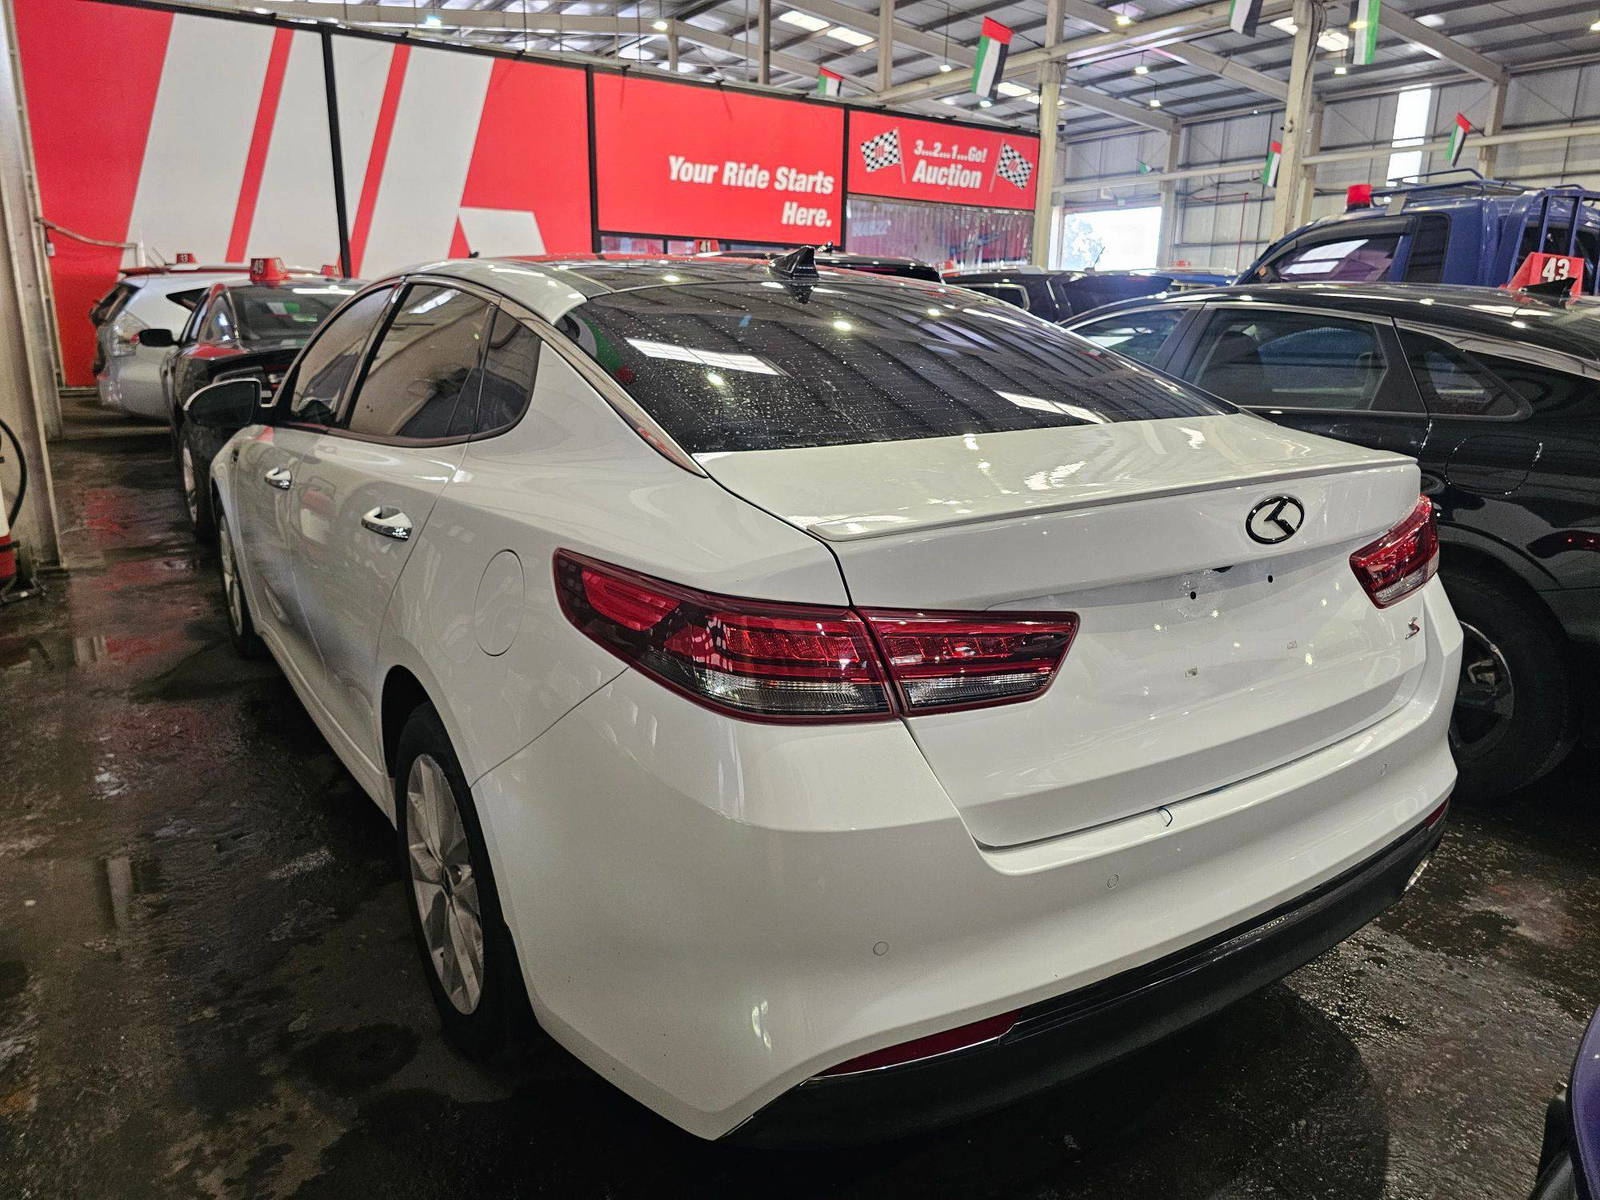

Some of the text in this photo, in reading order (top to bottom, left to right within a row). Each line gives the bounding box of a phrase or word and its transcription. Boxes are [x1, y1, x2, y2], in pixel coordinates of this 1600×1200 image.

[669, 155, 835, 195] Your Ride Starts
[912, 158, 983, 189] Auction
[781, 201, 832, 228] Here.
[1542, 257, 1570, 282] 43
